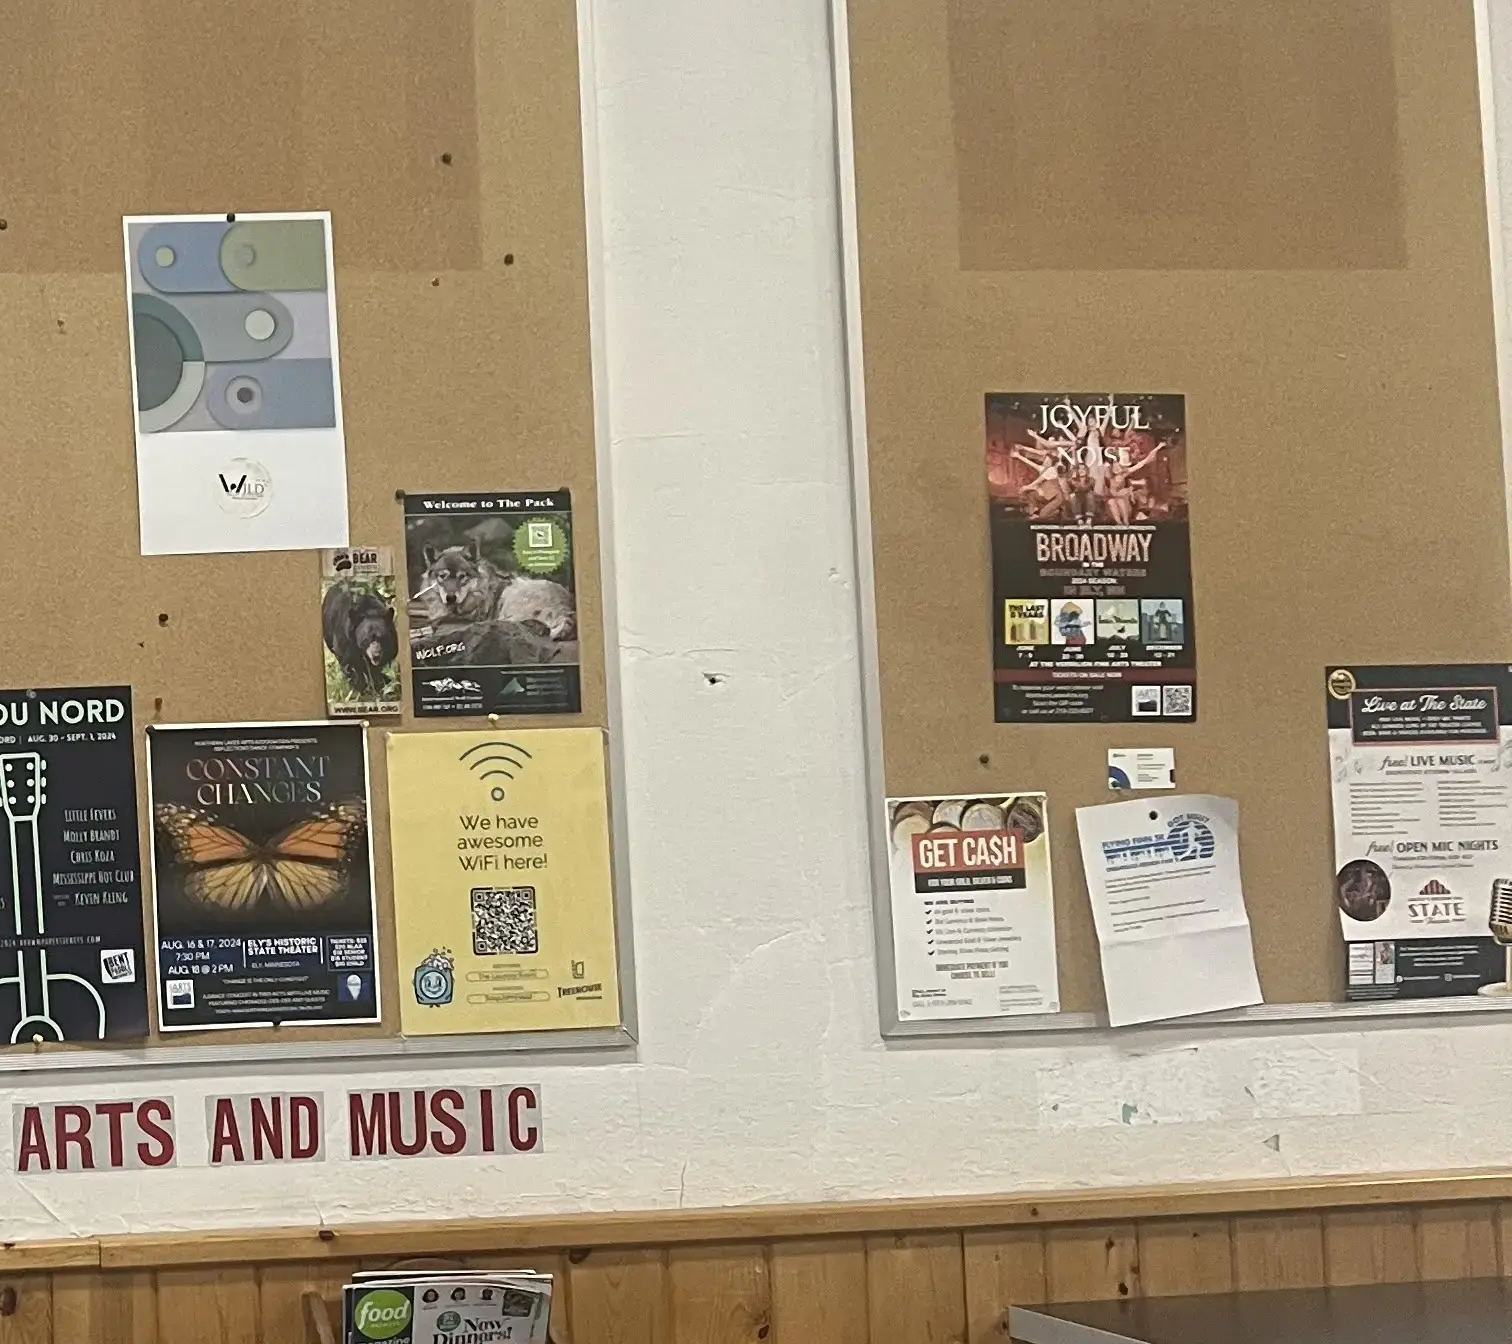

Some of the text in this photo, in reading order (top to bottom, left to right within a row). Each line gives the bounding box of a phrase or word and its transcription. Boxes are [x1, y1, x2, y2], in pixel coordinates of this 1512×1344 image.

[1039, 404, 1150, 435] JOYFUL
[1056, 446, 1132, 468] NOISE
[423, 497, 554, 509] Welcome to The Pack
[1036, 532, 1153, 562] BROADWAY
[353, 553, 377, 564] BEAR
[39, 699, 125, 725] NORD
[1361, 694, 1487, 713] Live at The State
[186, 756, 329, 781] CONSTANT
[1411, 756, 1434, 766] LIVE
[1439, 755, 1475, 766] MUSIC
[197, 781, 321, 805] CHANGES
[459, 813, 539, 831] We have
[457, 834, 543, 850] awesome
[1396, 842, 1428, 853] OPEN
[1432, 841, 1453, 852] MIC
[1458, 840, 1498, 851] NIGHTS
[459, 853, 548, 871] WiFi here!
[919, 838, 958, 869] GET
[1408, 902, 1465, 918] STATE
[195, 951, 210, 960] PM
[248, 946, 276, 956] STATE
[212, 964, 218, 973] 2
[219, 963, 234, 973] PM
[18, 1087, 538, 1172] ARTS AND MUSIC
[358, 1299, 410, 1330] food
